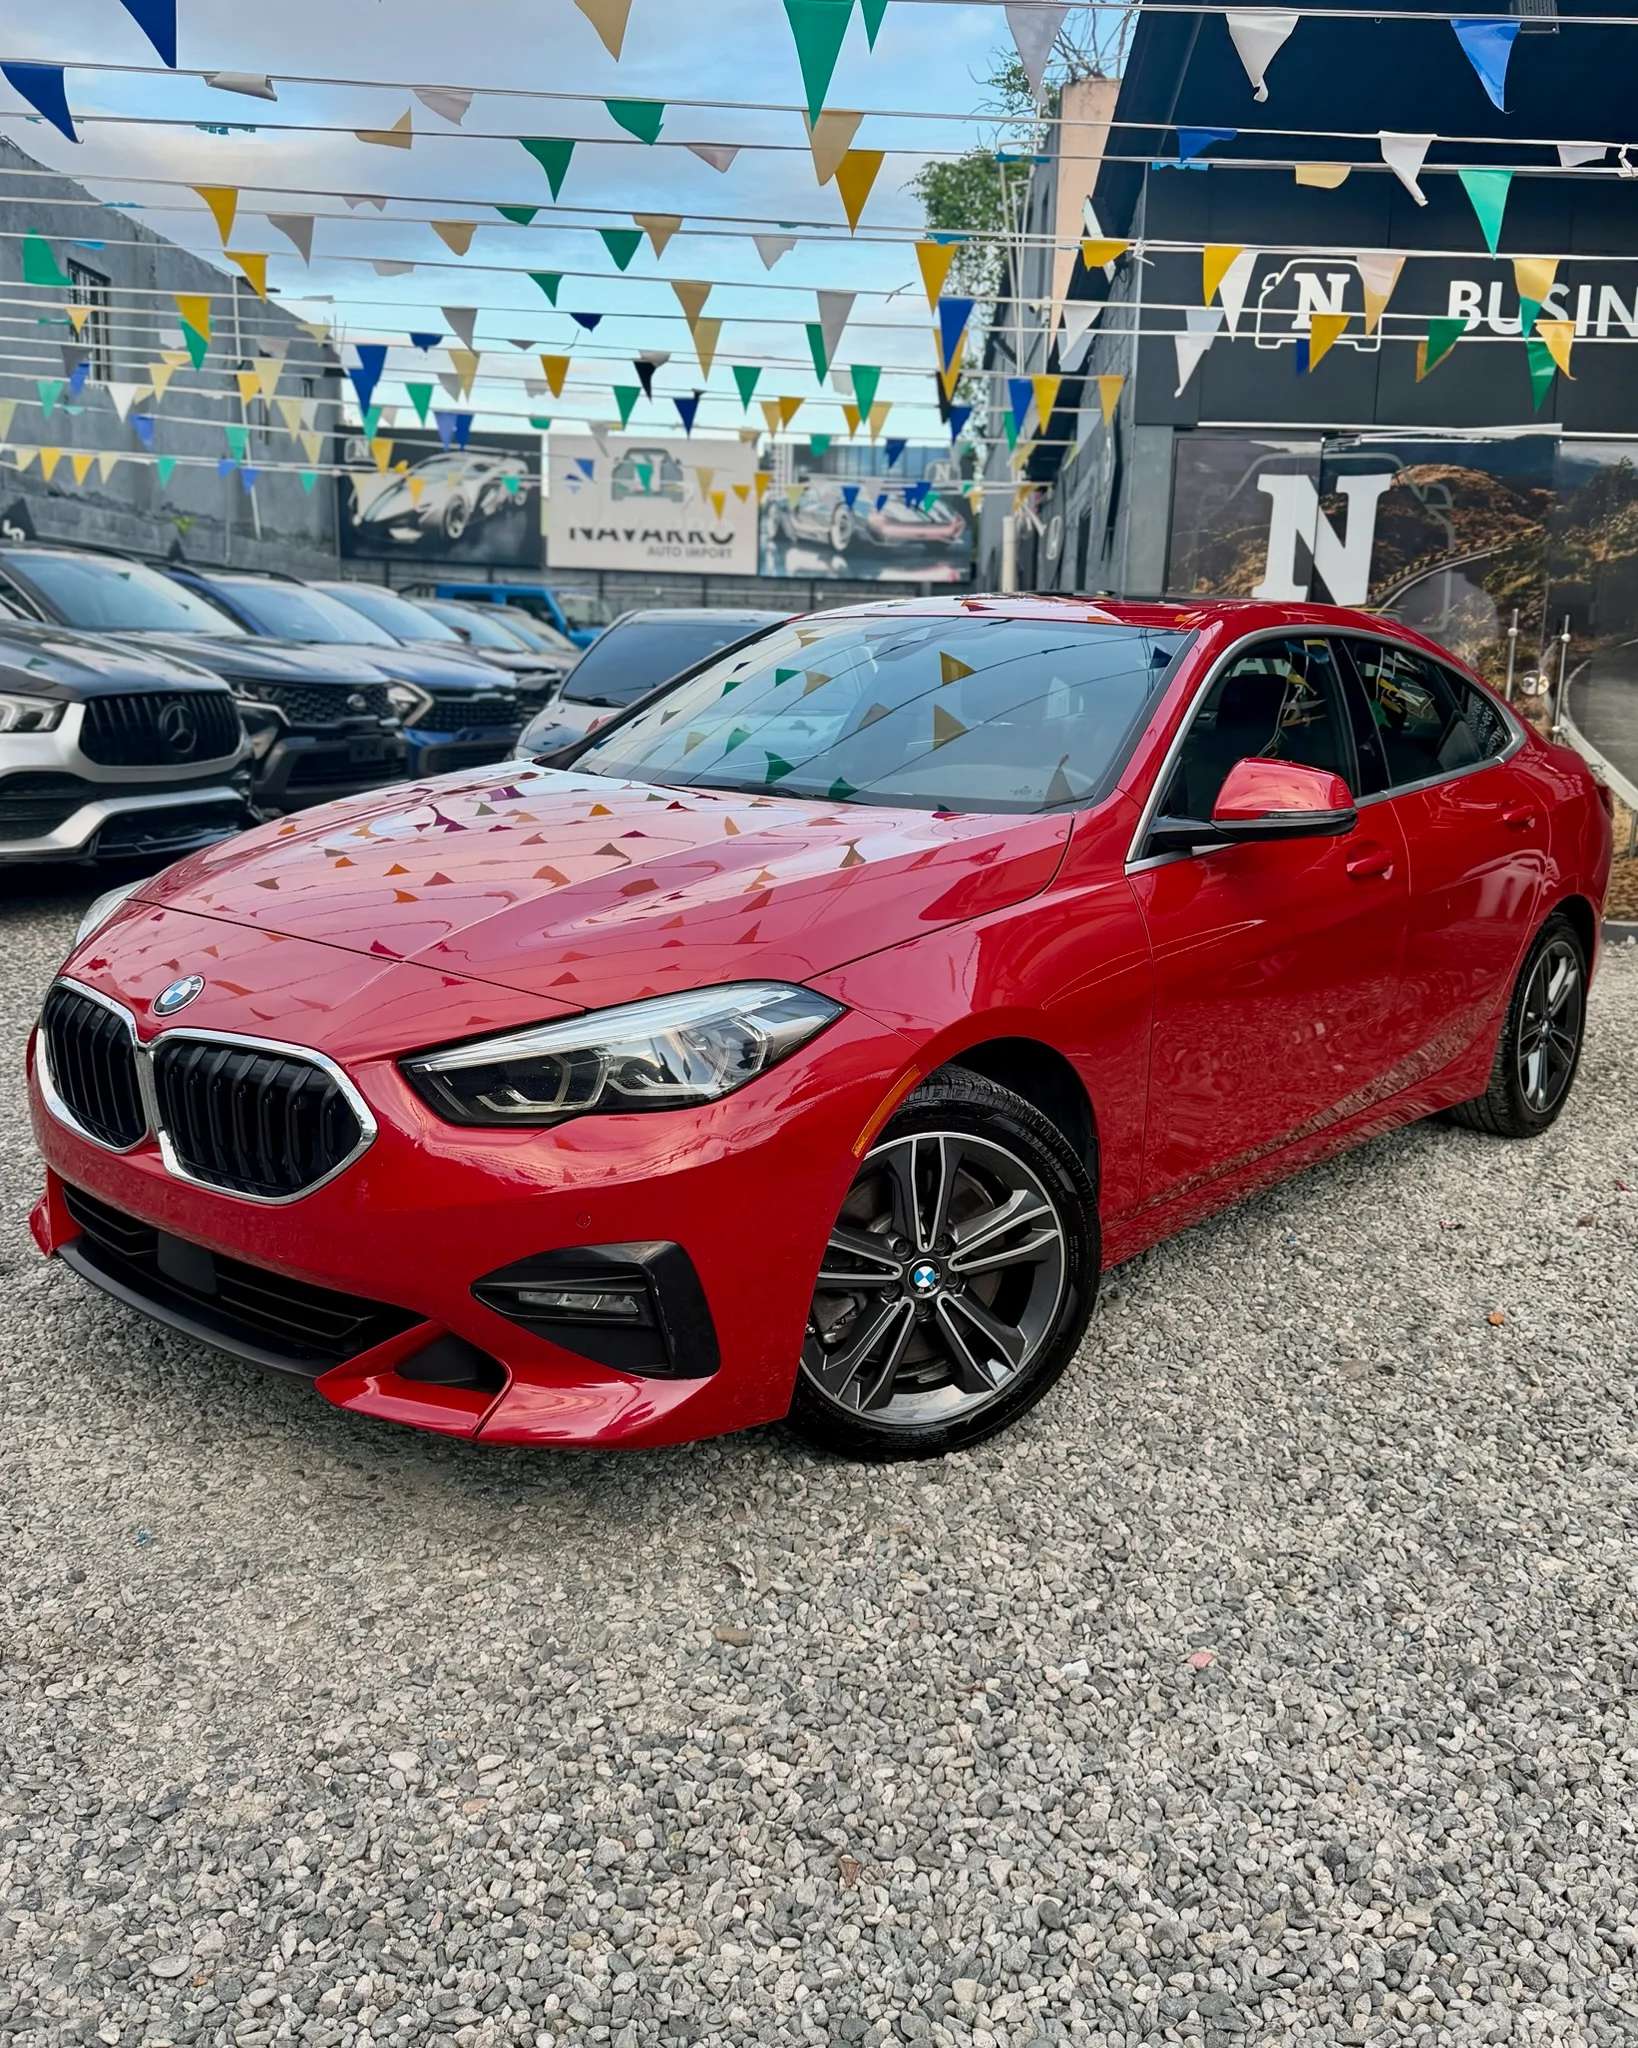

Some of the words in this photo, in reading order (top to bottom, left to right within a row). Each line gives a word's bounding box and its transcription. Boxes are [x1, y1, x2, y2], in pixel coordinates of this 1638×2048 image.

[1291, 272, 1351, 330] N
[647, 546, 683, 558] AUTO
[685, 546, 734, 560] IMPORT
[1252, 473, 1393, 607] N
